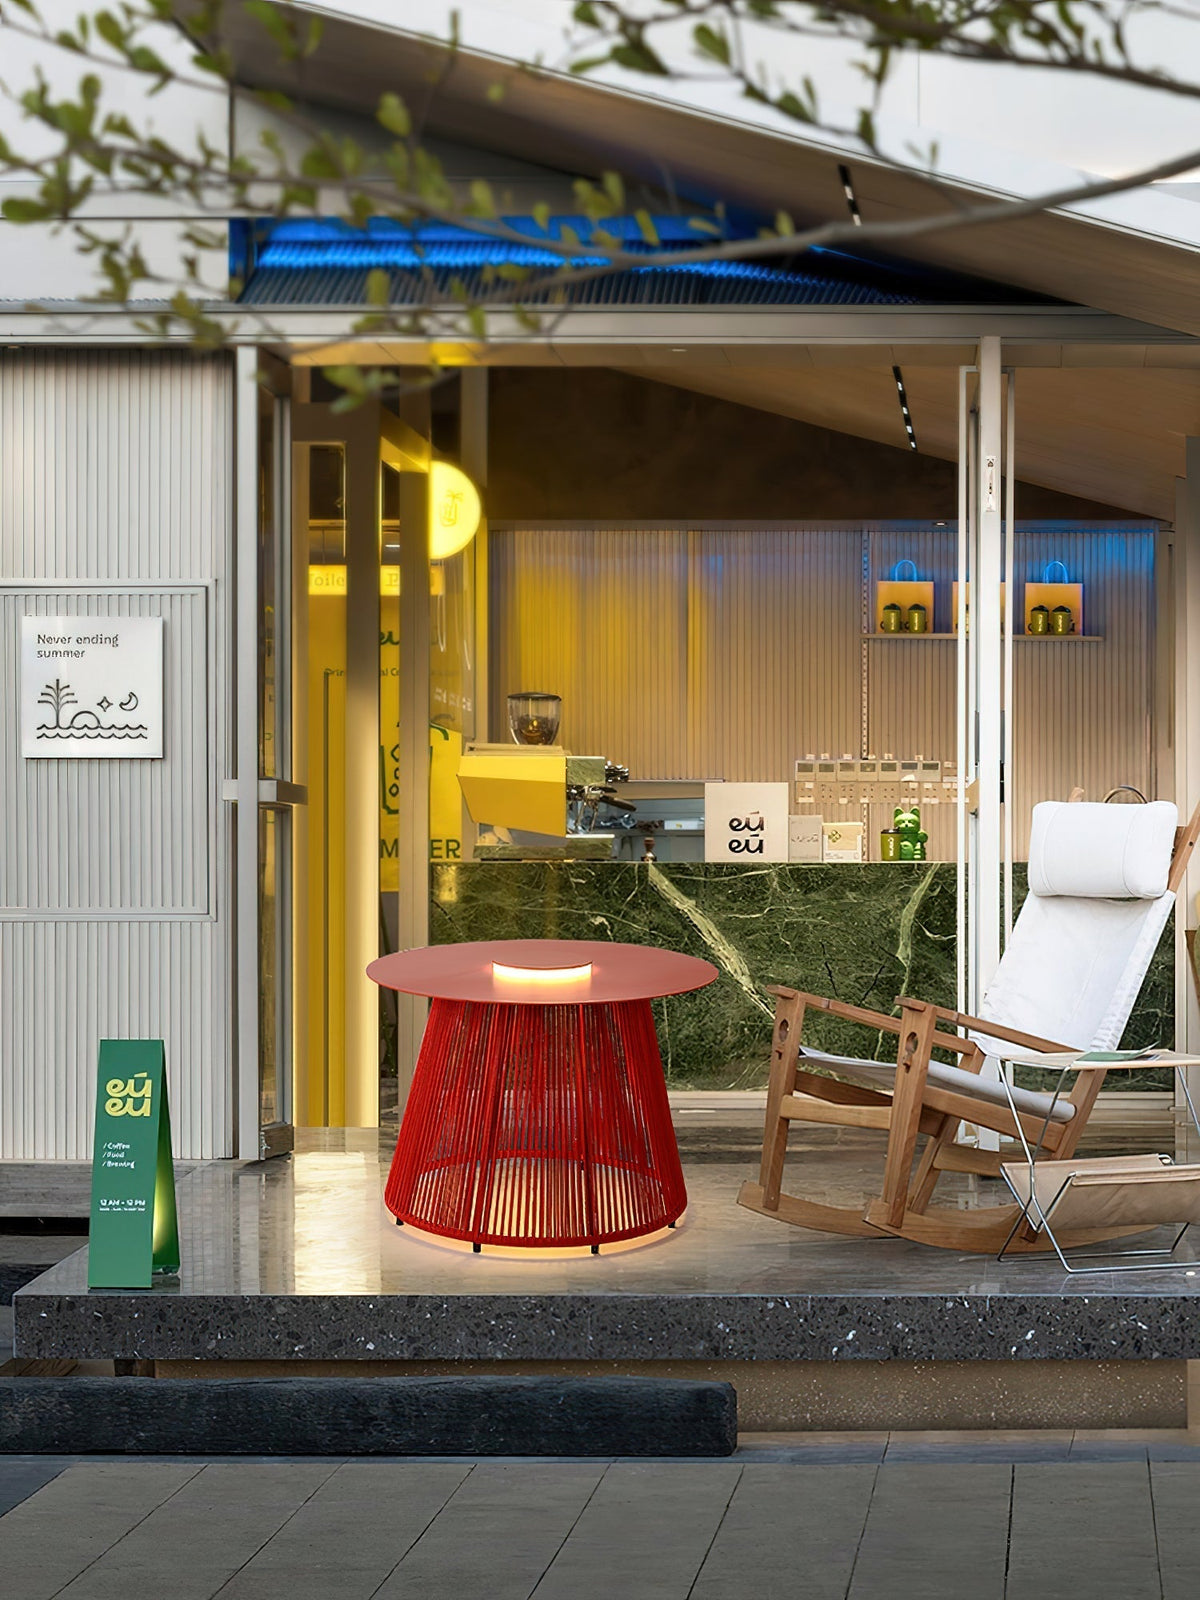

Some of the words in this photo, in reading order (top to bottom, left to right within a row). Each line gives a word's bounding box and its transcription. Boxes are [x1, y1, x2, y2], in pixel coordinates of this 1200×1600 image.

[37, 634, 72, 645] Never
[76, 633, 119, 648] ending
[37, 649, 86, 659] summer
[105, 1071, 153, 1098] eú
